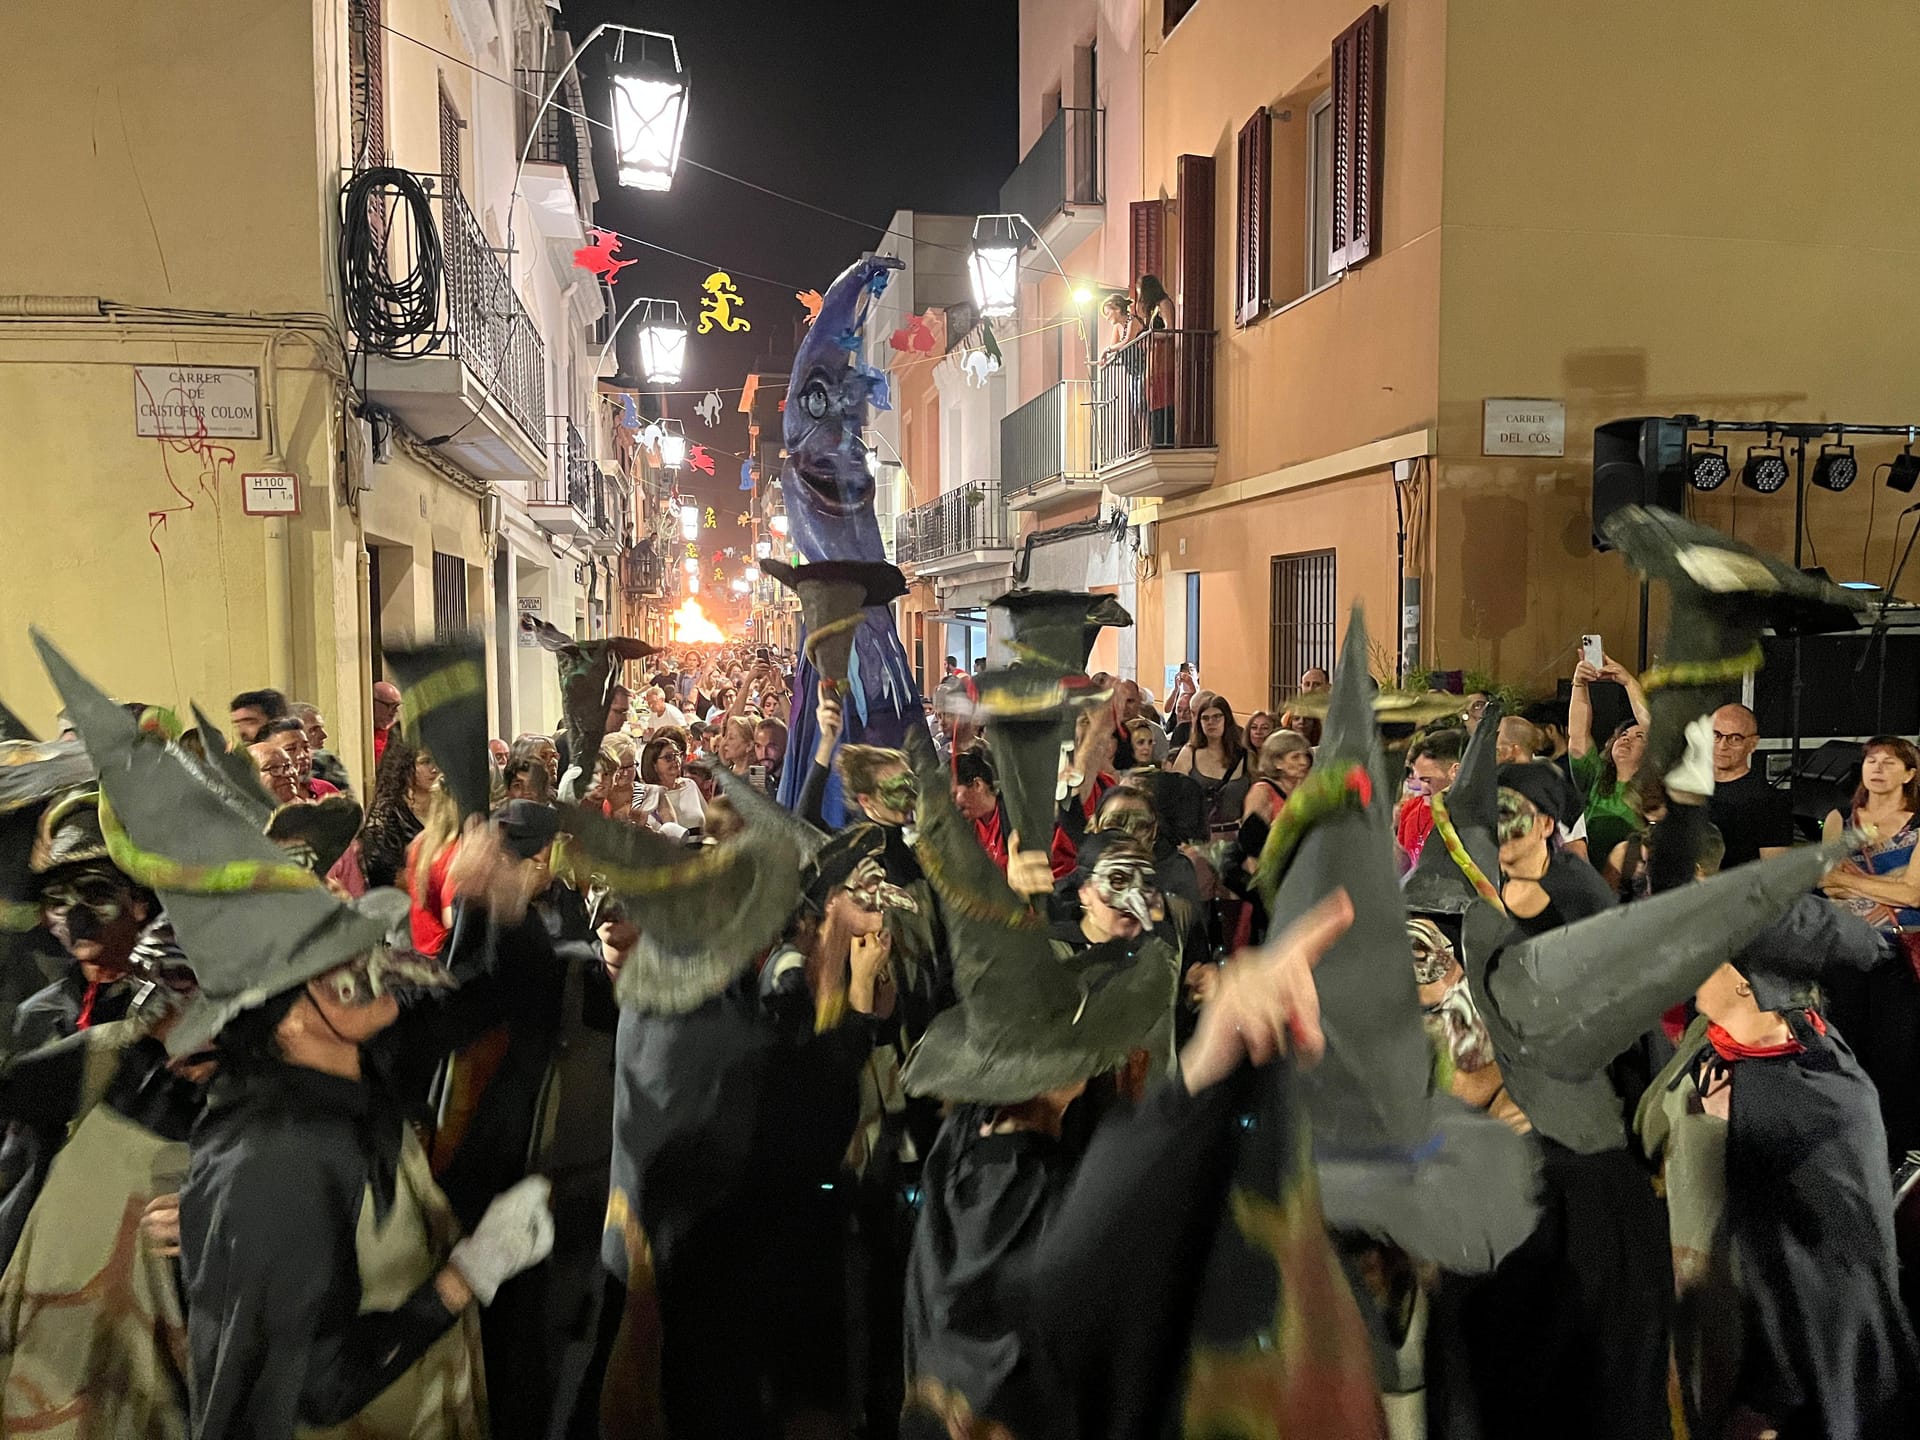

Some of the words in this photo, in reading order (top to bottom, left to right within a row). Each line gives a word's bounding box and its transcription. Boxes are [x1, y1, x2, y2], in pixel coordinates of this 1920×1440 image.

[169, 372, 222, 385] CARRER
[188, 388, 205, 400] DE
[140, 401, 206, 419] CRISTÒFOR
[211, 406, 253, 420] COLOM
[1506, 415, 1545, 424] CARRER
[1500, 432, 1524, 443] DEL
